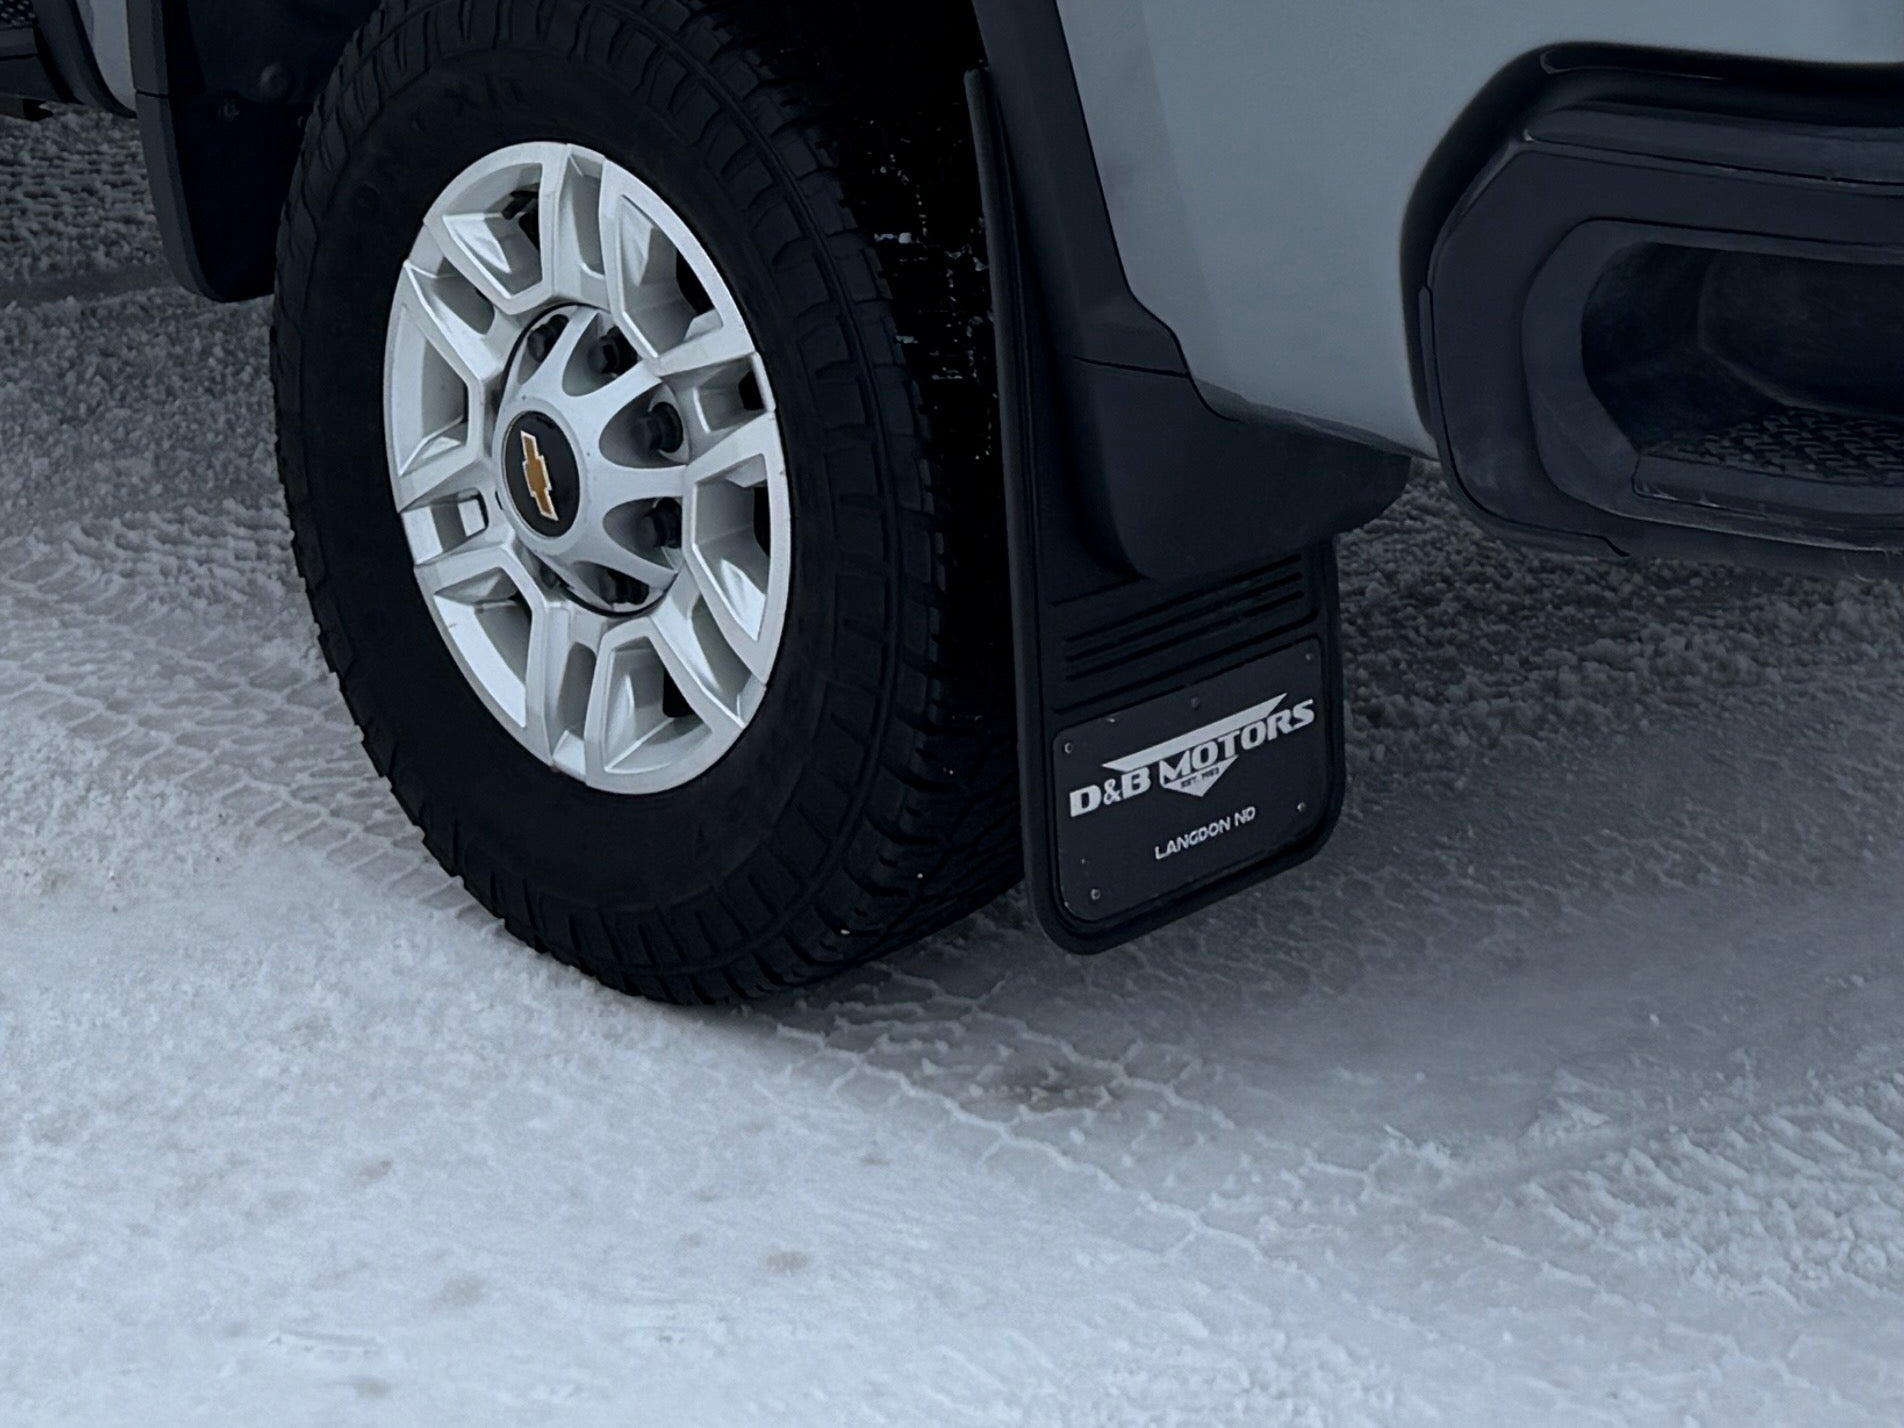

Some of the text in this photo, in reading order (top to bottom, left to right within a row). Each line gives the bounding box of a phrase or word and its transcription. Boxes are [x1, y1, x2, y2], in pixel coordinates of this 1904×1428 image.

[1069, 698, 1316, 818] D&B MOTORS
[1154, 805, 1257, 861] LANGDON ND
